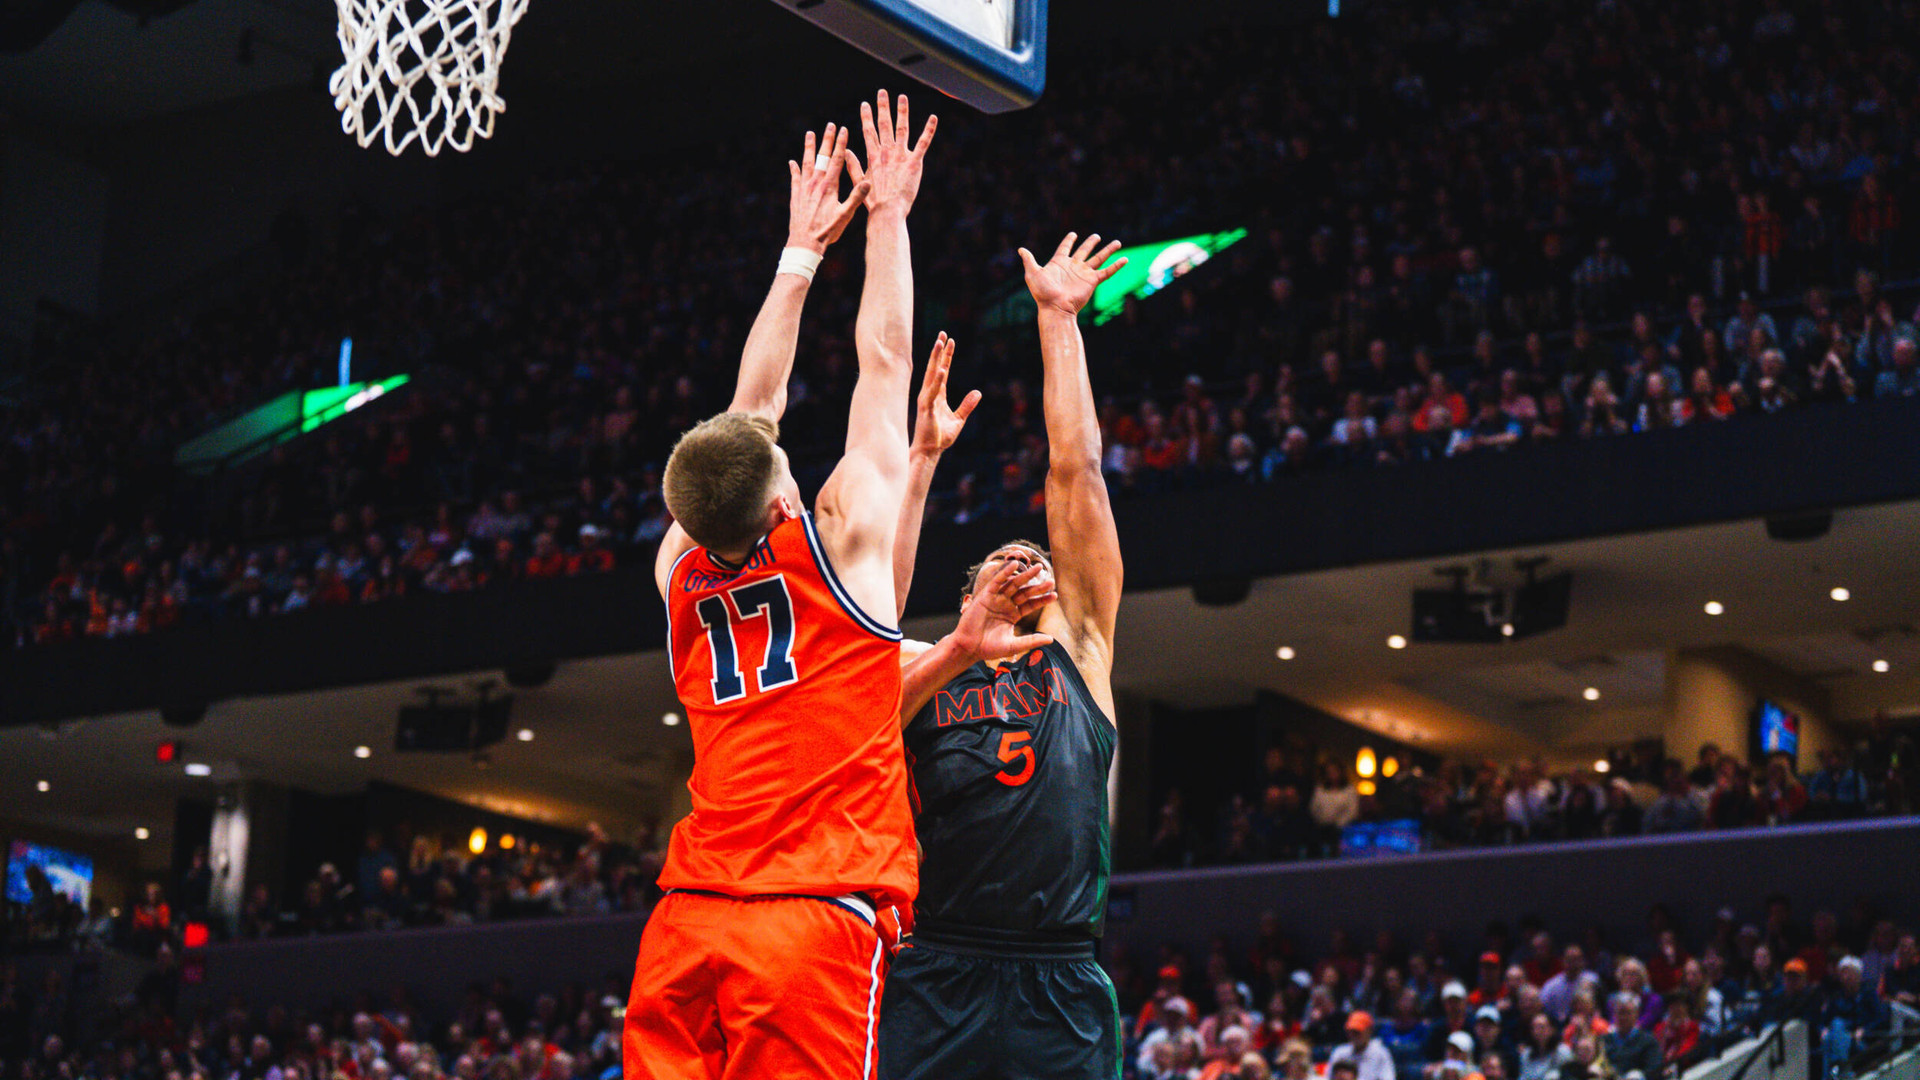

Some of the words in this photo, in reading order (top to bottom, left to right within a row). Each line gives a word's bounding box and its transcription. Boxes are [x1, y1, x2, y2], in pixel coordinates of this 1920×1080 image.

[695, 573, 799, 706] 17
[935, 667, 1069, 727] MIAMI
[994, 730, 1036, 787] 5
